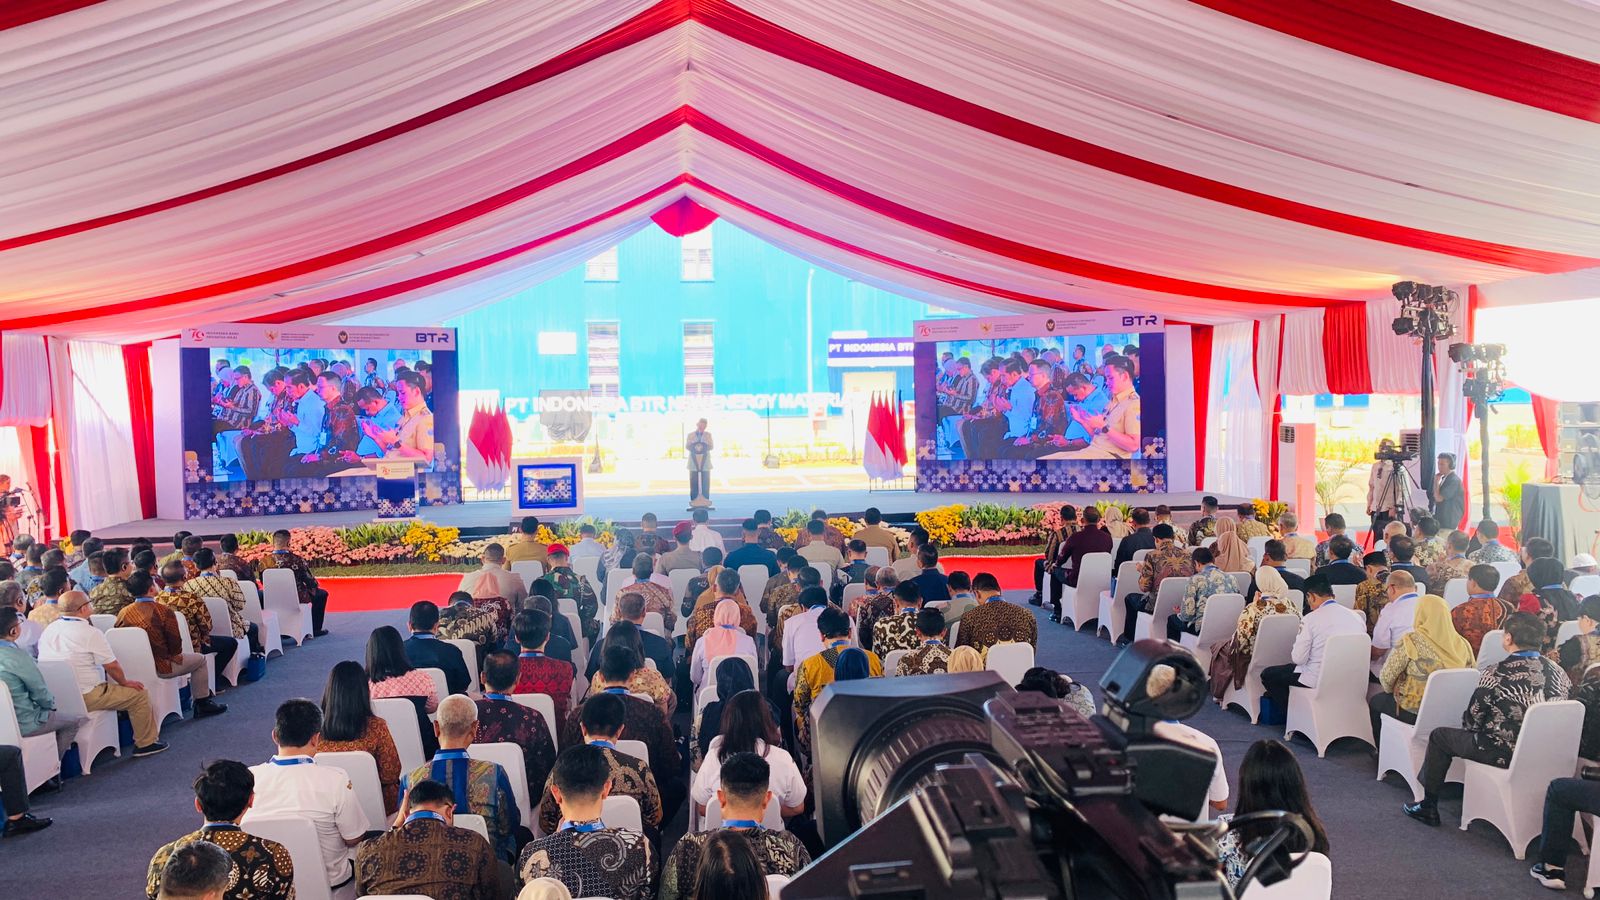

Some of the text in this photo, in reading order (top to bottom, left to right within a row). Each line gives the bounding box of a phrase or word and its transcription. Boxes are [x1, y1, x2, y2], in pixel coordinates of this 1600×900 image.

[1122, 315, 1158, 326] BTR
[415, 332, 449, 343] BTR
[828, 343, 842, 353] PT
[843, 342, 897, 353] INDONESIA
[505, 396, 526, 412] PT
[533, 395, 628, 413] INDONESIA
[631, 395, 666, 414] BTR
